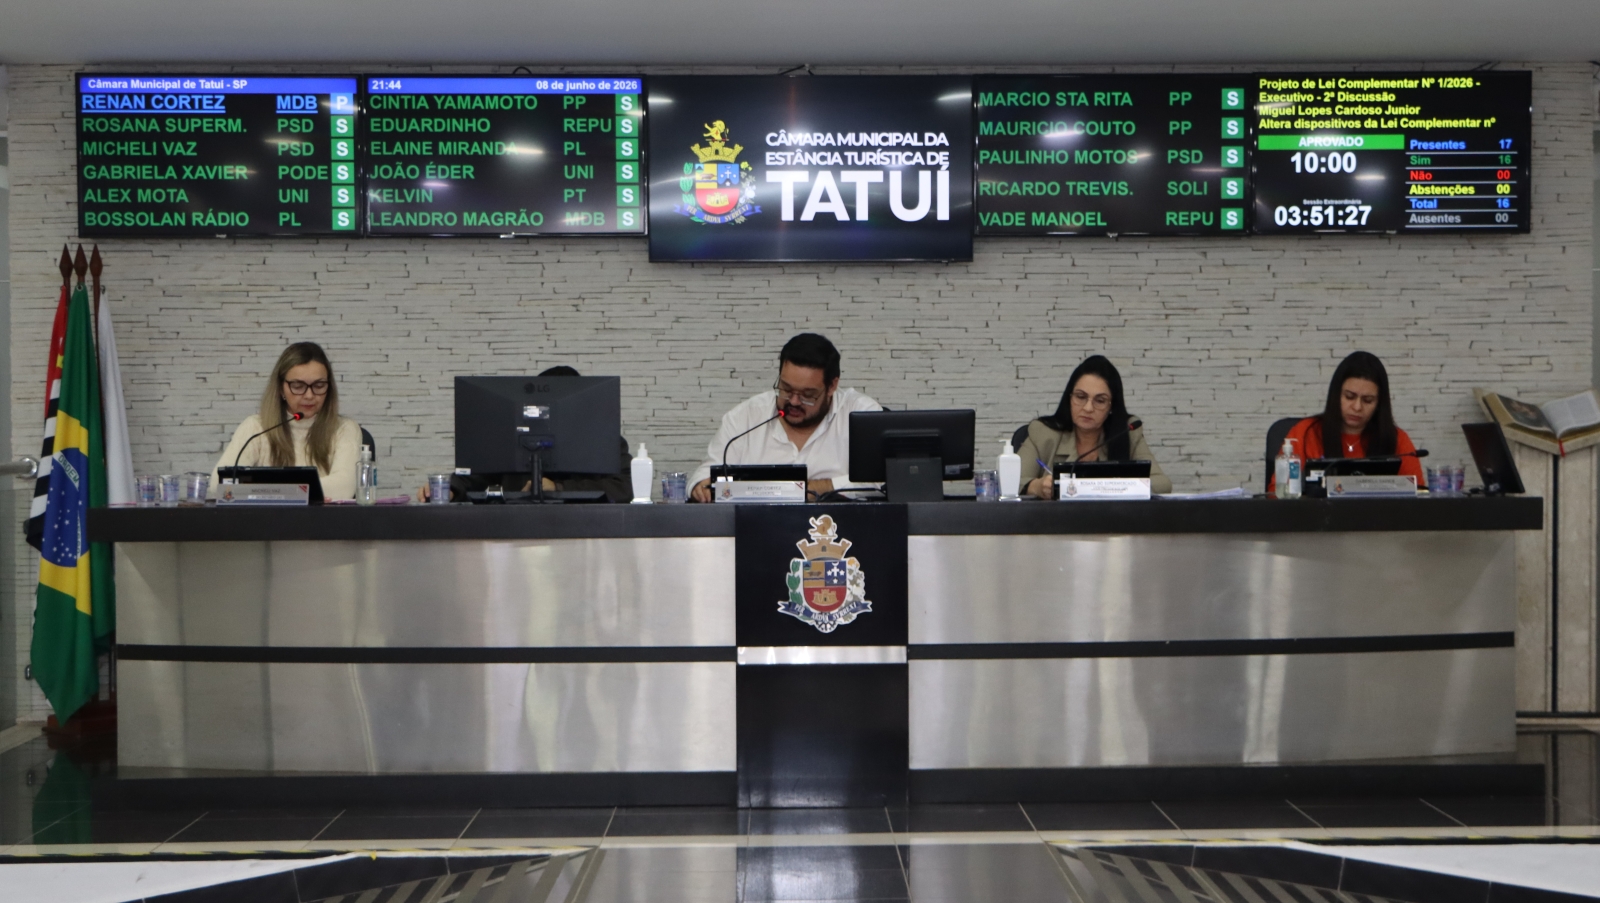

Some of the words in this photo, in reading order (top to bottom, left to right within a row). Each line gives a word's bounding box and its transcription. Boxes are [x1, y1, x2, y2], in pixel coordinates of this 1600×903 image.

[88, 79, 128, 89] Câmara
[130, 80, 181, 90] Municipal
[184, 80, 196, 89] de
[233, 80, 248, 89] SP
[372, 81, 401, 90] 21:44
[536, 81, 548, 90] 08
[551, 81, 563, 90] de
[566, 81, 596, 91] junho
[599, 81, 611, 90] de
[614, 81, 638, 90] 2026
[1259, 79, 1299, 91] Projeto
[1302, 79, 1316, 88] de
[1318, 78, 1335, 88] Lei
[1338, 78, 1419, 90] Complementar
[1437, 78, 1473, 88] 1/2026
[82, 95, 146, 109] RENAN
[151, 95, 226, 109] CORTEZ
[276, 95, 318, 110] MDB
[337, 97, 348, 109] P
[369, 96, 428, 110] CINTIA
[433, 96, 538, 110] YAMAMOTO
[563, 96, 586, 110] PP
[621, 97, 632, 111] S
[979, 92, 1050, 106] MARCIO
[1055, 92, 1089, 106] STA
[1094, 92, 1133, 106] RITA
[1169, 92, 1192, 106] PP
[1226, 92, 1239, 106] S
[1259, 92, 1314, 102] Executivo
[1338, 92, 1396, 101] Discussão
[1259, 105, 1295, 117] Miguel
[1298, 105, 1332, 117] Lopes
[1335, 105, 1382, 115] Cardoso
[1385, 105, 1420, 115] Junior
[82, 119, 160, 132] ROSANA
[165, 119, 247, 132] SUPERM.
[277, 119, 314, 133] PSD
[336, 119, 348, 133] S
[370, 119, 491, 133] EDUARDINHO
[563, 119, 612, 133] REPU
[621, 120, 633, 133] S
[979, 122, 1068, 136] MAURICIO
[1074, 122, 1135, 135] COUTO
[1169, 122, 1192, 135] PP
[1226, 121, 1239, 135] S
[1259, 118, 1291, 128] Altera
[1294, 118, 1361, 130] dispositivos
[1364, 118, 1378, 128] da
[1380, 118, 1397, 128] Lei
[1400, 118, 1481, 129] Complementar
[766, 129, 835, 147] CÂMARA
[837, 132, 924, 147] MUNICIPAL
[924, 132, 949, 146] DA
[1299, 137, 1363, 147] APROVADO
[1410, 140, 1466, 150] Presentes
[1499, 139, 1512, 149] 17
[82, 142, 157, 156] MICHELI
[162, 142, 197, 156] VAZ
[278, 142, 314, 156] PSD
[337, 142, 348, 156] S
[370, 142, 433, 155] ELAINE
[438, 142, 518, 155] MIRANDA
[564, 142, 586, 155] PL
[622, 142, 633, 156] S
[766, 150, 843, 166] ESTÂNCIA
[844, 149, 924, 166] TURÍSTICA
[926, 152, 949, 165] DE
[979, 150, 1068, 164] PAULINHO
[1074, 150, 1138, 164] MOTOS
[1168, 150, 1203, 163] PSD
[1226, 150, 1238, 163] S
[1290, 152, 1356, 173] 10:00
[1410, 155, 1431, 165] Sim
[1499, 155, 1511, 164] 16
[83, 166, 177, 180] GABRIELA
[182, 166, 248, 180] XAVIER
[278, 166, 328, 180] PODE
[337, 166, 349, 180] S
[370, 163, 420, 179] JOÃO
[426, 162, 475, 179] ÉDER
[564, 165, 594, 179] UNI
[622, 166, 633, 179] S
[1410, 170, 1432, 180] Não
[1497, 170, 1510, 179] 00
[766, 164, 950, 221] TATUÍ
[979, 181, 1060, 195] RICARDO
[1066, 181, 1134, 196] TREVIS.
[1167, 181, 1207, 195] SOLI
[1226, 181, 1238, 195] S
[1409, 184, 1475, 196] Abstenções
[1496, 184, 1510, 194] 00
[84, 189, 131, 203] ALEX
[137, 189, 189, 203] MOTA
[279, 189, 308, 203] UNI
[338, 189, 349, 203] S
[370, 189, 433, 203] KELVIN
[564, 189, 586, 203] PT
[622, 189, 634, 203] S
[1410, 199, 1437, 209] Total
[1497, 199, 1509, 208] 16
[85, 212, 186, 226] BOSSOLAN
[192, 209, 249, 226] RÁDIO
[279, 213, 301, 226] PL
[338, 213, 349, 226] S
[370, 212, 457, 226] LEANDRO
[463, 209, 544, 226] MAGRÃO
[565, 213, 605, 226] MDB
[623, 213, 633, 226] S
[979, 212, 1026, 226] VADE
[1031, 212, 1107, 226] MANOEL
[1166, 212, 1213, 225] REPU
[1226, 212, 1238, 225] S
[1274, 206, 1372, 226] 03:51:27
[1410, 214, 1461, 223] Ausentes
[1495, 214, 1508, 222] 00
[58, 454, 79, 484] ORDEM
